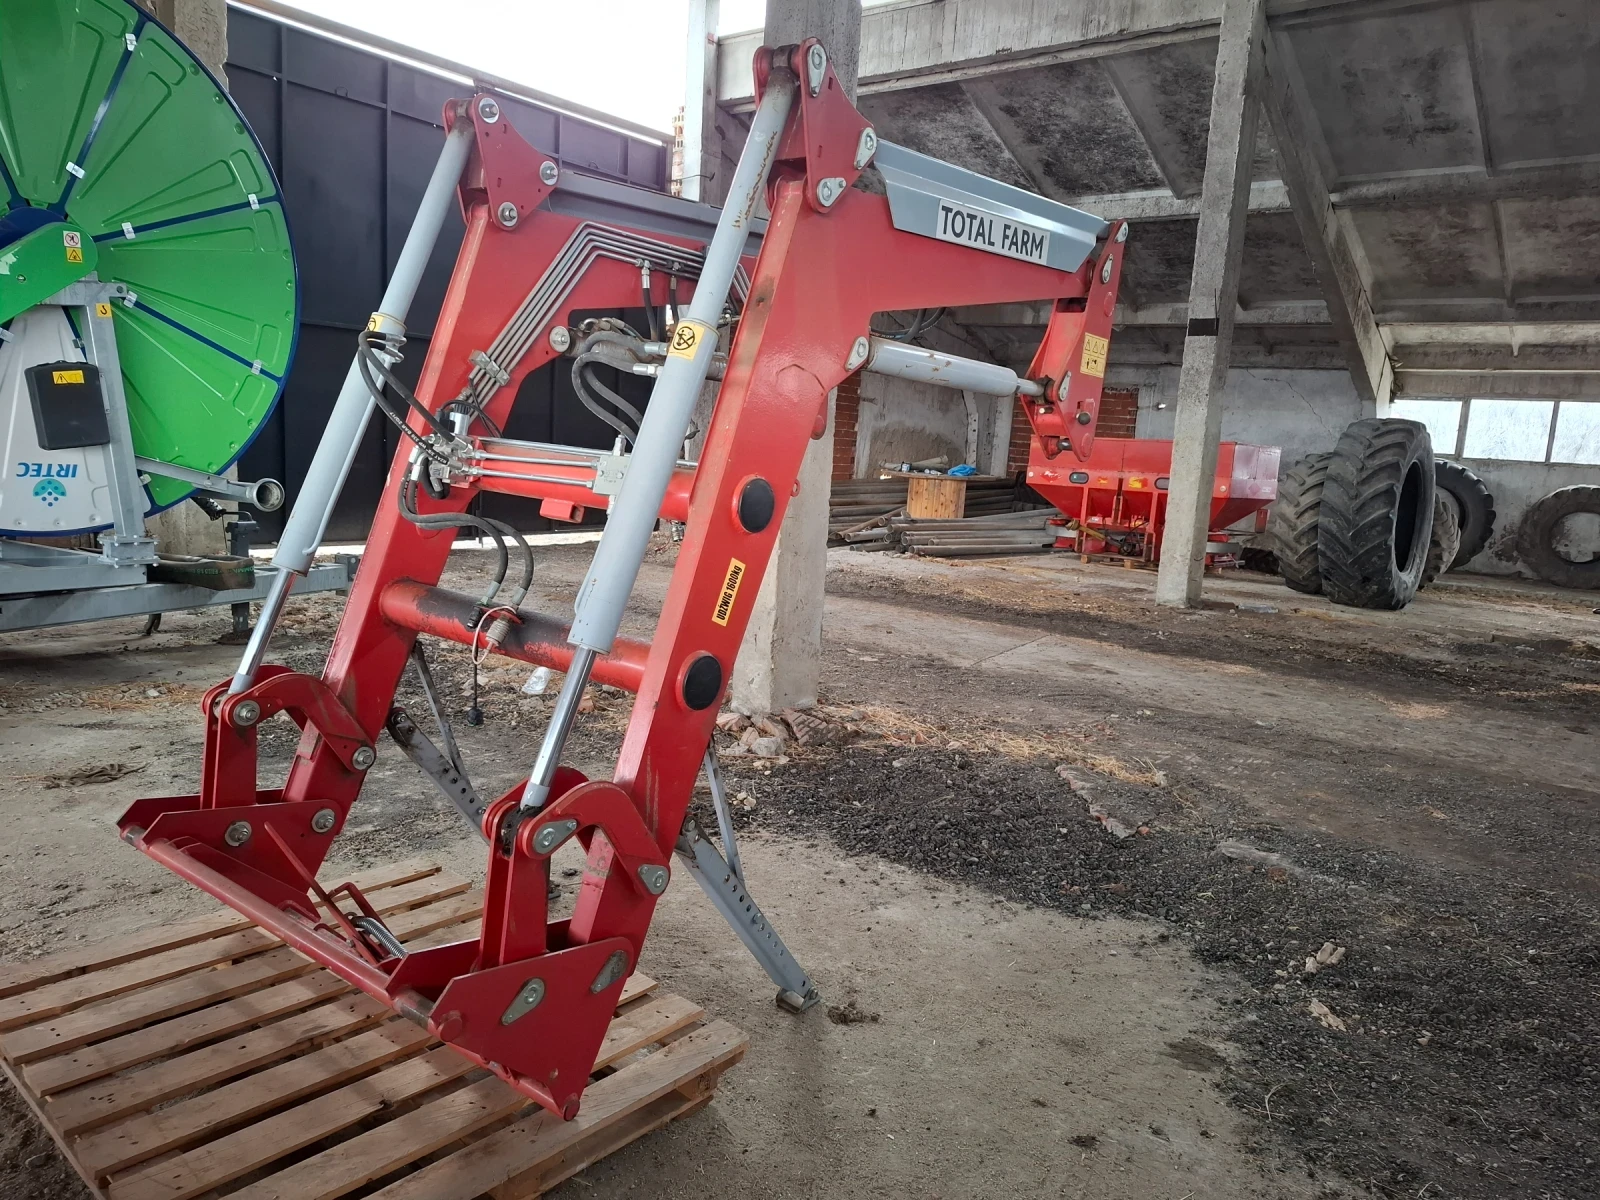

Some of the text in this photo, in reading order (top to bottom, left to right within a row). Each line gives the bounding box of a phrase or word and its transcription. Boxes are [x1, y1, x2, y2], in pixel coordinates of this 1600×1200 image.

[942, 205, 1044, 259] TOTAL FARM
[401, 425, 412, 435] BAR
[16, 462, 78, 478] IRTEC
[716, 565, 743, 621] UDŹWIG 1600kg
